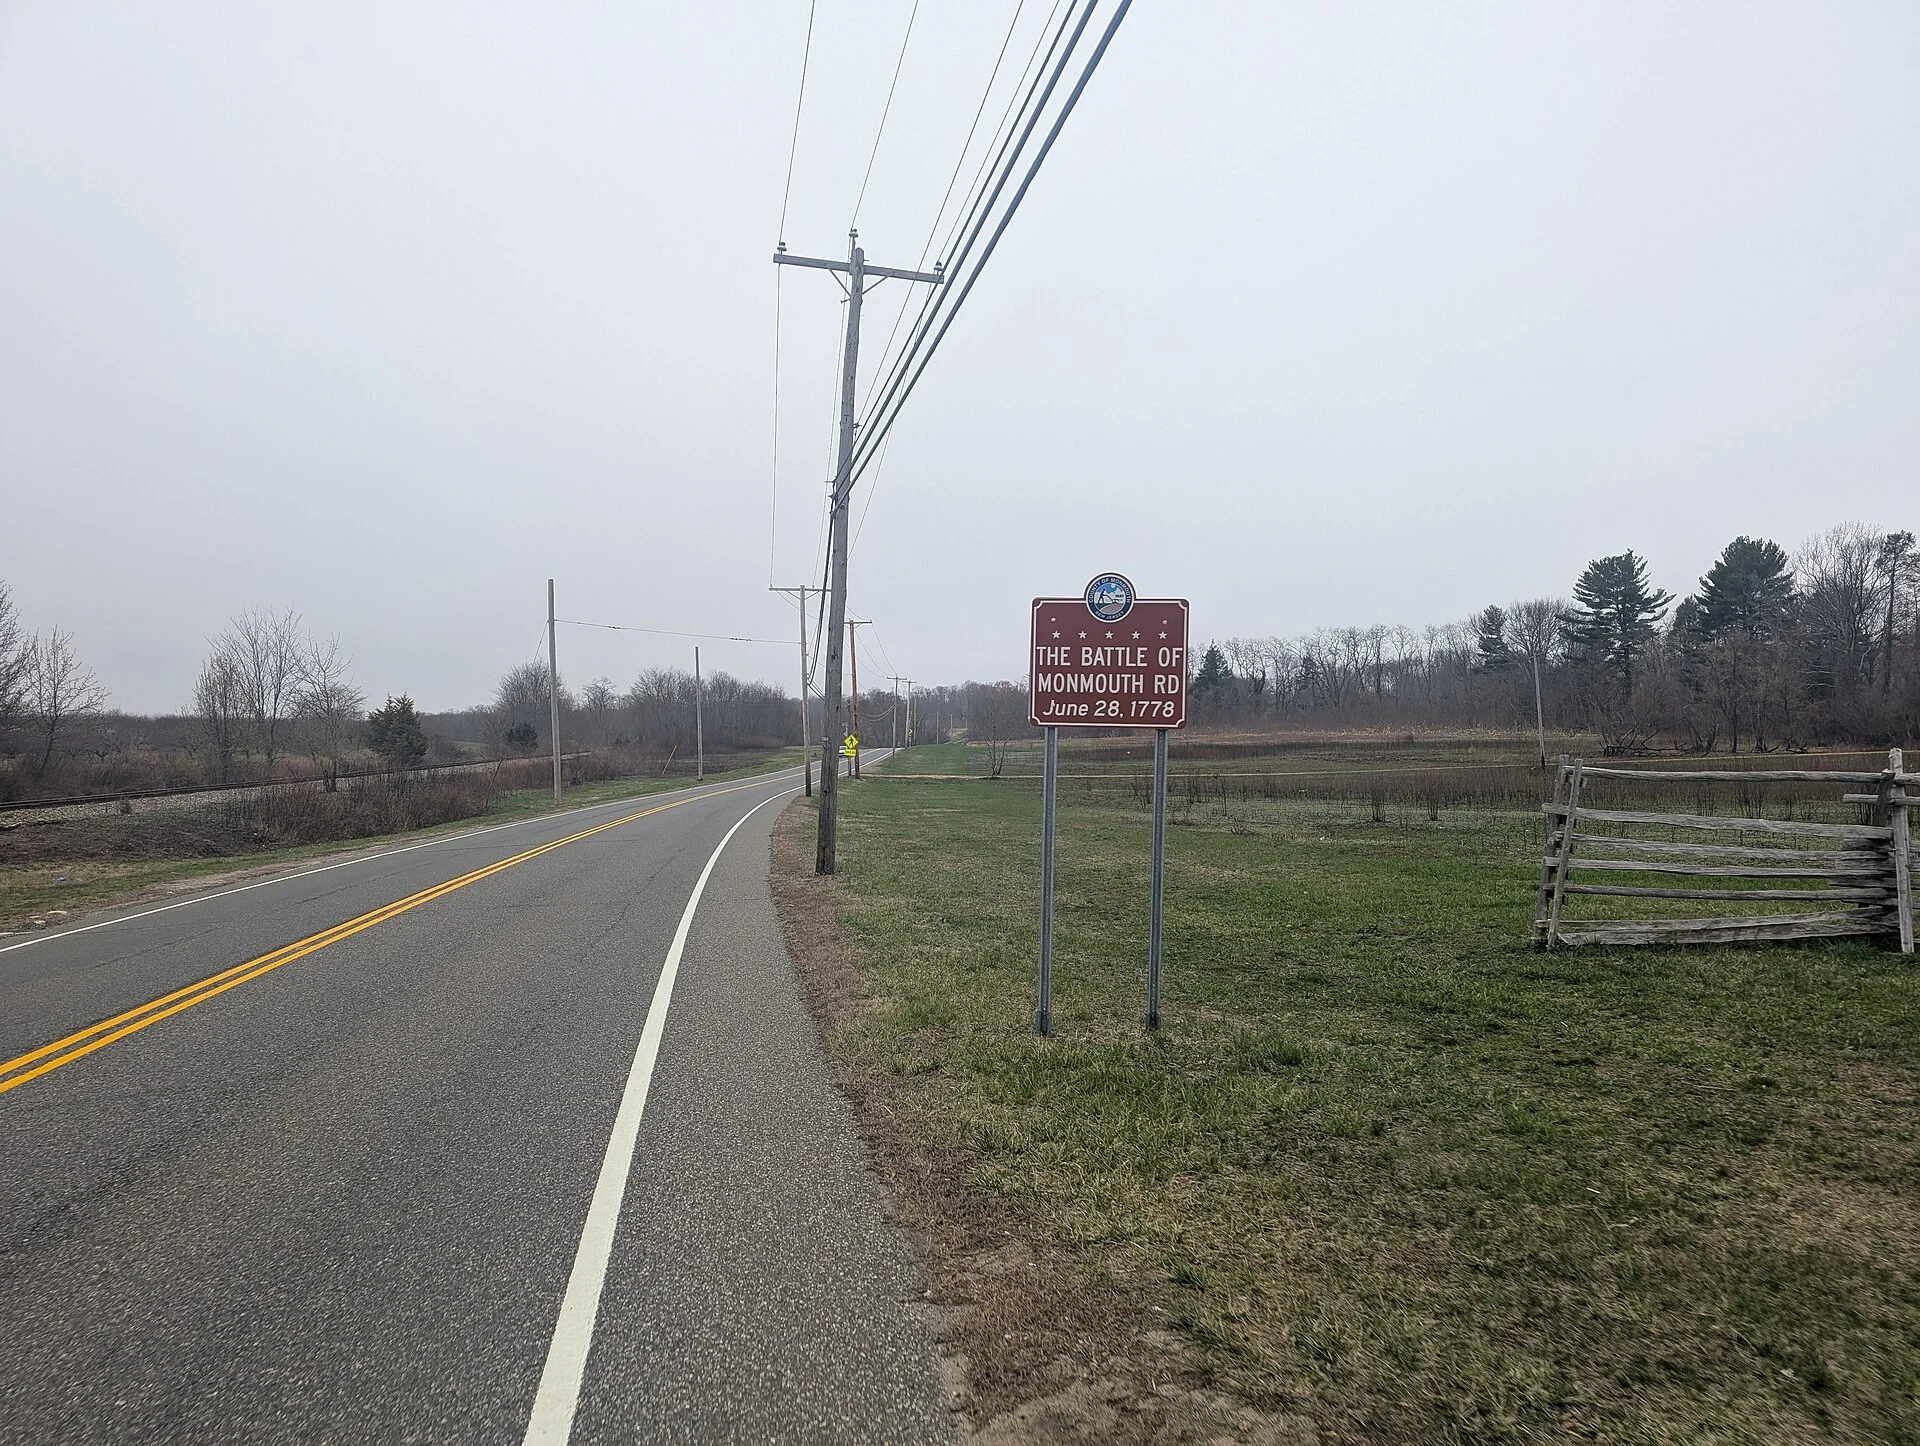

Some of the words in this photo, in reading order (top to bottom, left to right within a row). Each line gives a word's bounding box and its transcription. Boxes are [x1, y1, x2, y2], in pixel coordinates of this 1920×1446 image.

[1089, 582, 1101, 603] COUNTY
[1037, 646, 1071, 666] THE
[1081, 646, 1148, 666] BATTLE
[1158, 647, 1183, 667] OF
[1038, 673, 1143, 694] MONMOUTH
[1154, 674, 1180, 694] RD
[1043, 700, 1089, 717] June
[1094, 700, 1124, 718] 28,
[1130, 701, 1175, 717] 1778
